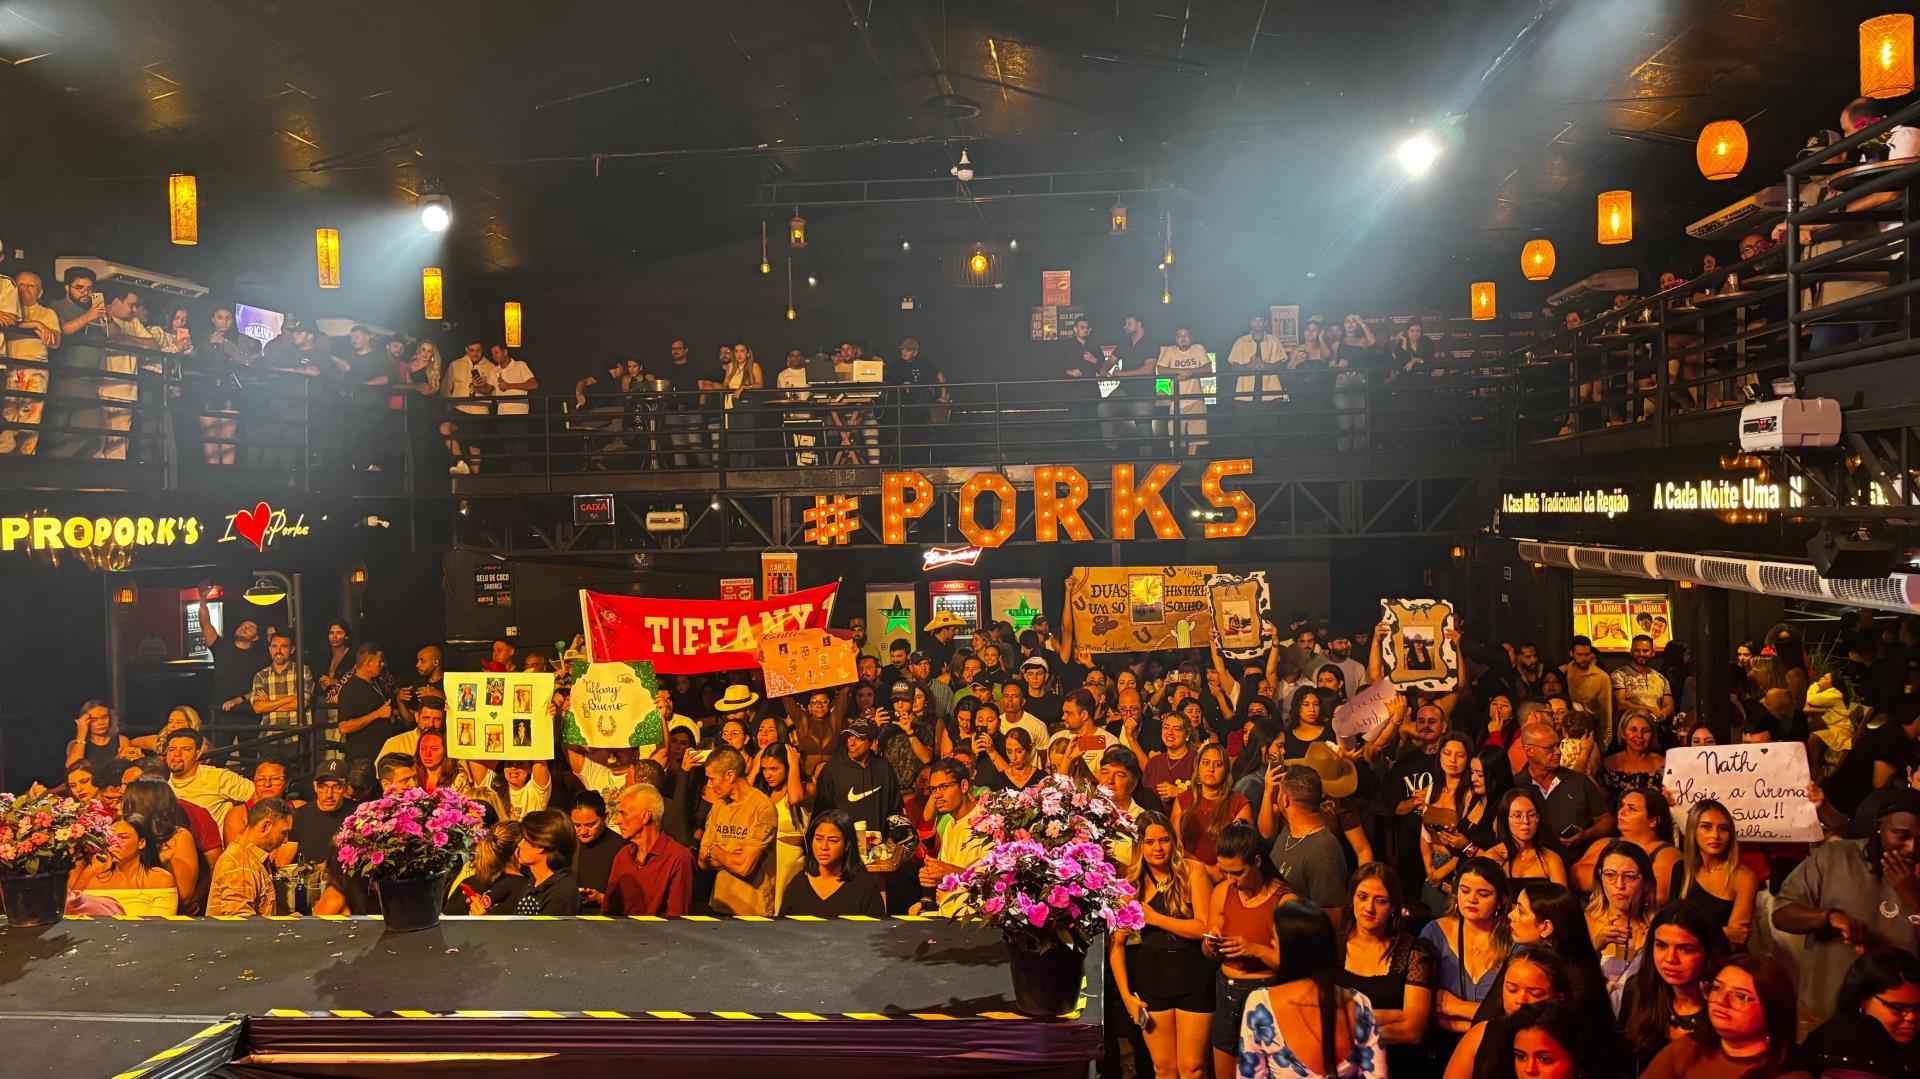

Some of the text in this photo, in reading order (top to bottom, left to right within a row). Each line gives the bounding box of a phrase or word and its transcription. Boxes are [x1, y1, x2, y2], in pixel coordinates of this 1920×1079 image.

[1174, 358, 1197, 367] BOSS
[1653, 482, 1663, 509] A
[1665, 480, 1697, 509] Cada
[1700, 479, 1738, 509] Noite
[1742, 478, 1780, 509] Uma
[580, 503, 608, 511] CAIXA
[1502, 488, 1629, 518] A Casa Mais Tradicional da Região
[264, 508, 310, 546] Porks
[476, 573, 510, 582] GELO DE COCO
[1090, 584, 1128, 599] DUAS
[1089, 603, 1109, 615] UM
[1111, 599, 1127, 615] SÓ
[1594, 604, 1622, 614] BRAHMA
[1633, 604, 1662, 614] BRAHMA
[644, 603, 813, 656] TIFFANY
[583, 679, 622, 703] Tiffany
[588, 699, 628, 711] Bueno
[1697, 750, 1758, 775] Nath
[1727, 787, 1746, 799] a
